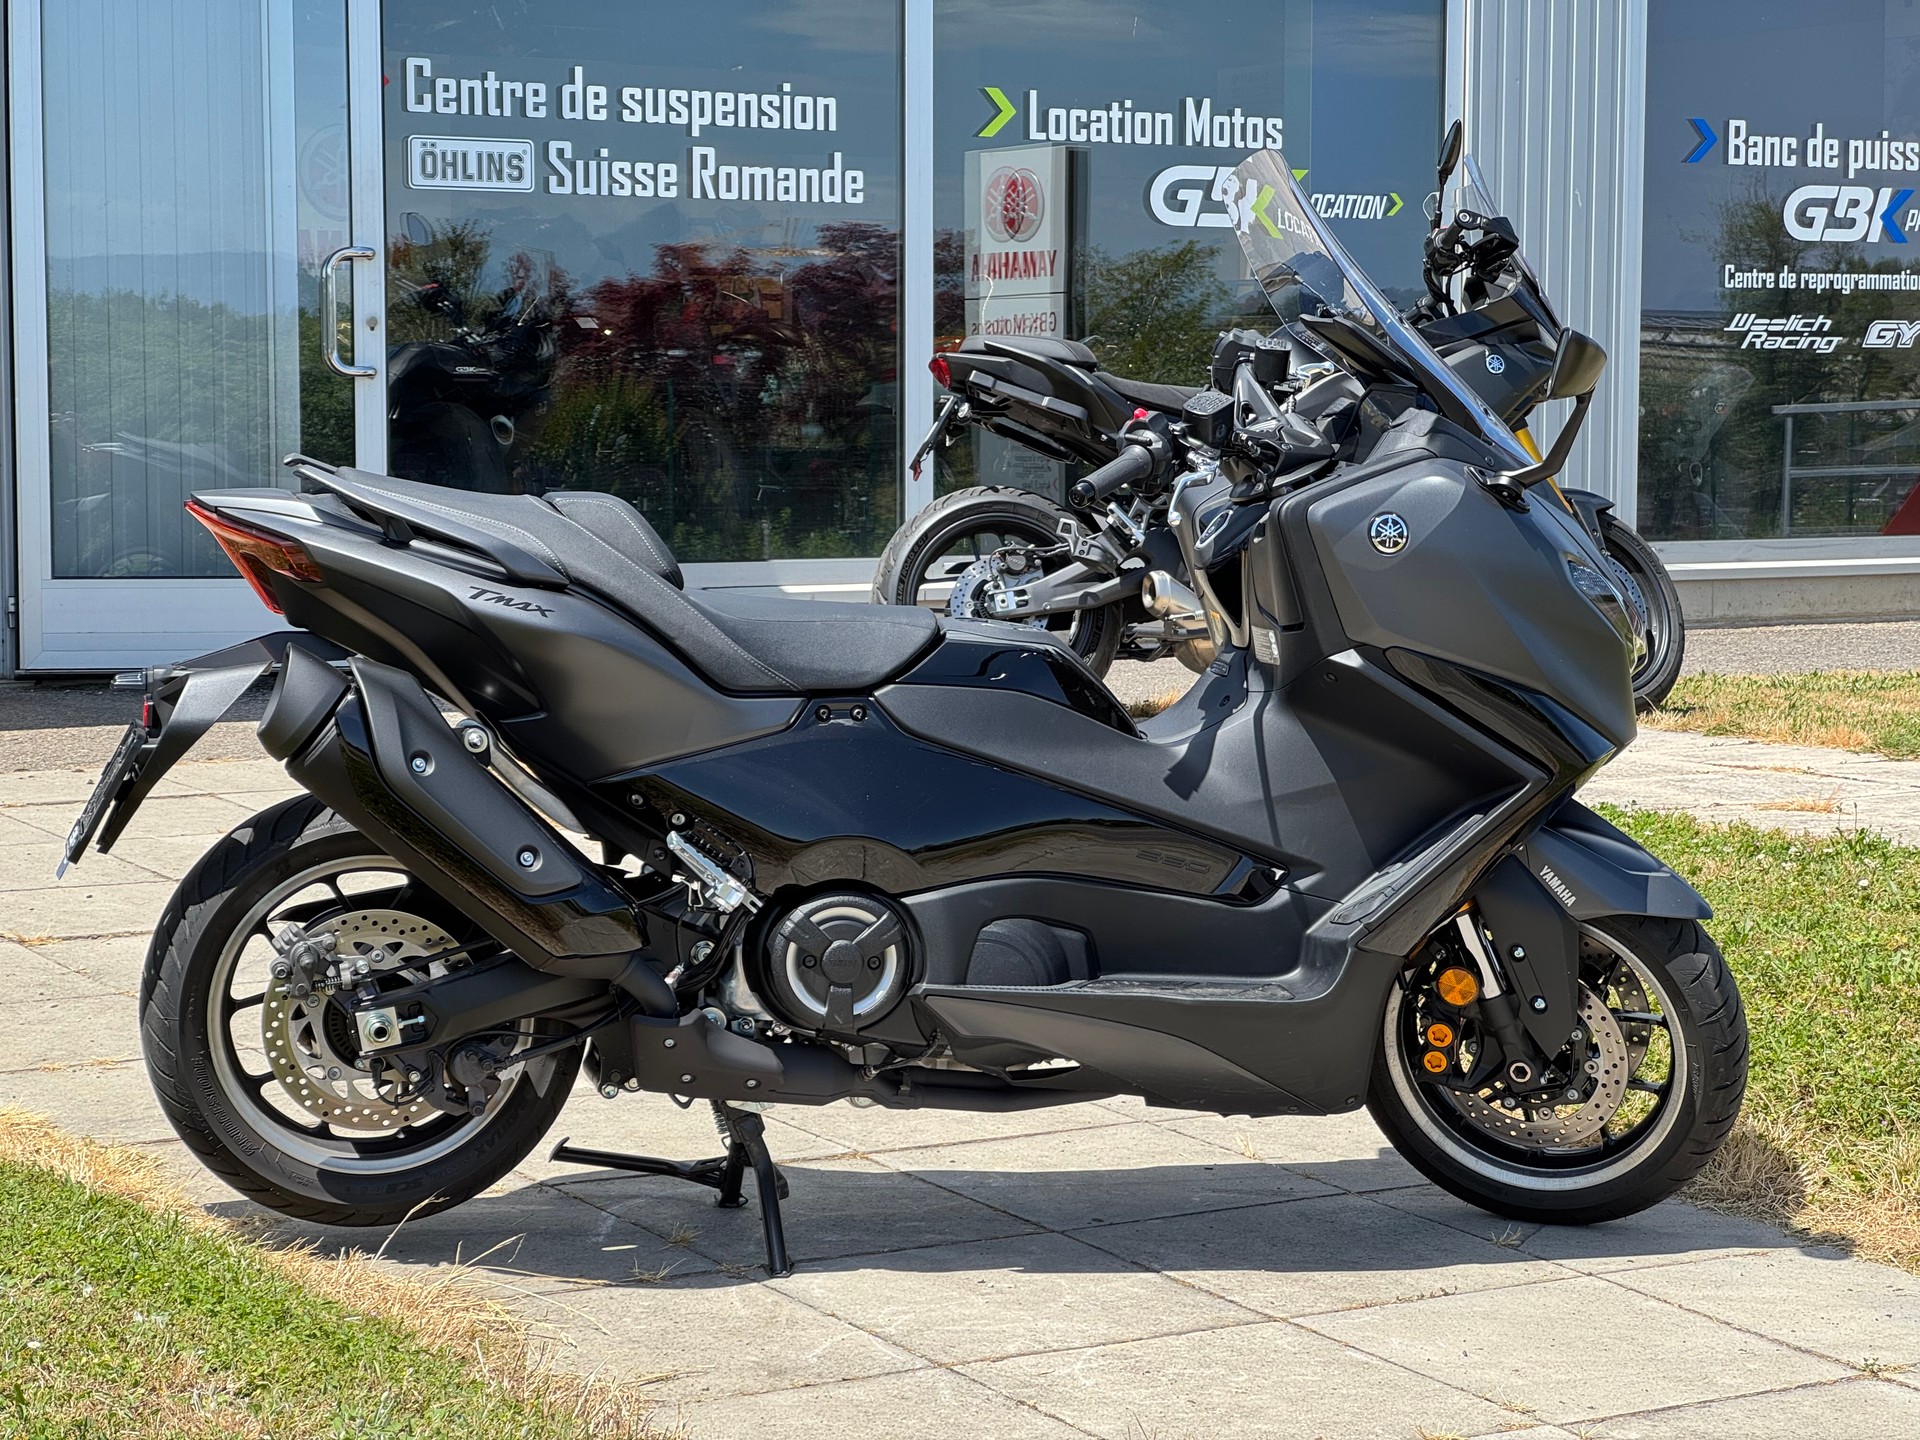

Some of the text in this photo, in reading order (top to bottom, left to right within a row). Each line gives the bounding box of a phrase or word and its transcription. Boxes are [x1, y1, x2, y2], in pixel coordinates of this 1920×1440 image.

[407, 57, 837, 137] Centre de suspension
[1029, 90, 1283, 149] Location Motos
[548, 140, 864, 204] Suisse Romande
[1728, 119, 1920, 179] Banc de puiss
[1310, 193, 1388, 220] OCATION
[1783, 185, 1916, 244] GBK
[1724, 264, 1920, 295] Centre de reprogrammatio
[1740, 332, 1843, 354] Racing
[902, 552, 915, 577] ROAD
[1539, 864, 1577, 908] YAMAHA
